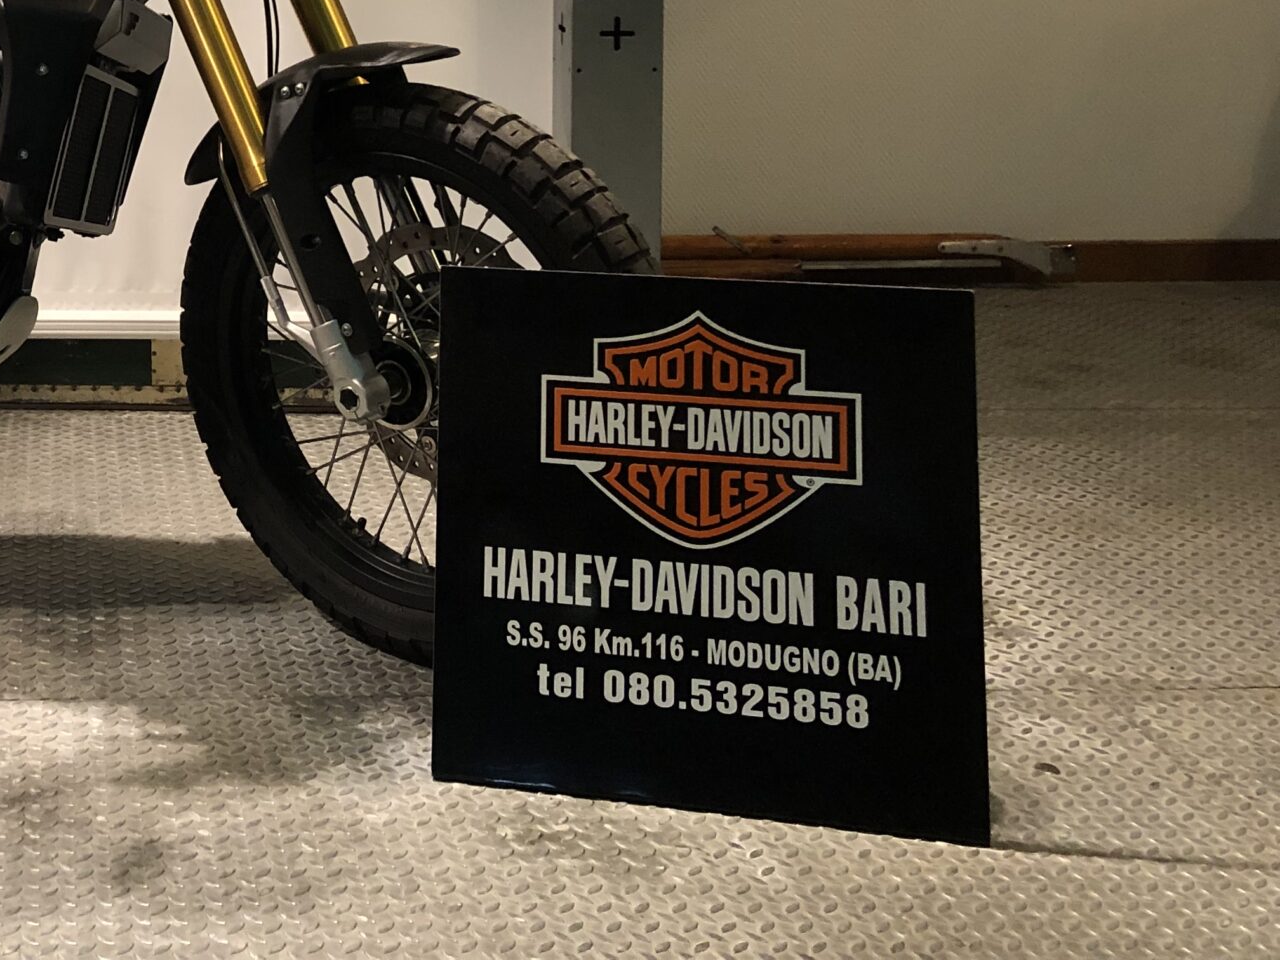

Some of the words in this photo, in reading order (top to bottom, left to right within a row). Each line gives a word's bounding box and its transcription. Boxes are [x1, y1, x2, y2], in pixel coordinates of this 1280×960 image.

[630, 340, 769, 394] MOTOR
[567, 399, 833, 460] HARLEY-DAVIDSON
[628, 463, 769, 527] CYCLES
[483, 546, 814, 627] HARLEY-DAVIDSON
[836, 575, 927, 638] BARI
[506, 619, 550, 649] S.S.
[557, 624, 587, 653] 96
[594, 628, 684, 662] Km.116
[707, 638, 840, 677] MODUGNO
[848, 651, 902, 691] (BA)
[537, 663, 585, 700] tel
[603, 669, 870, 729] 080.5325858
